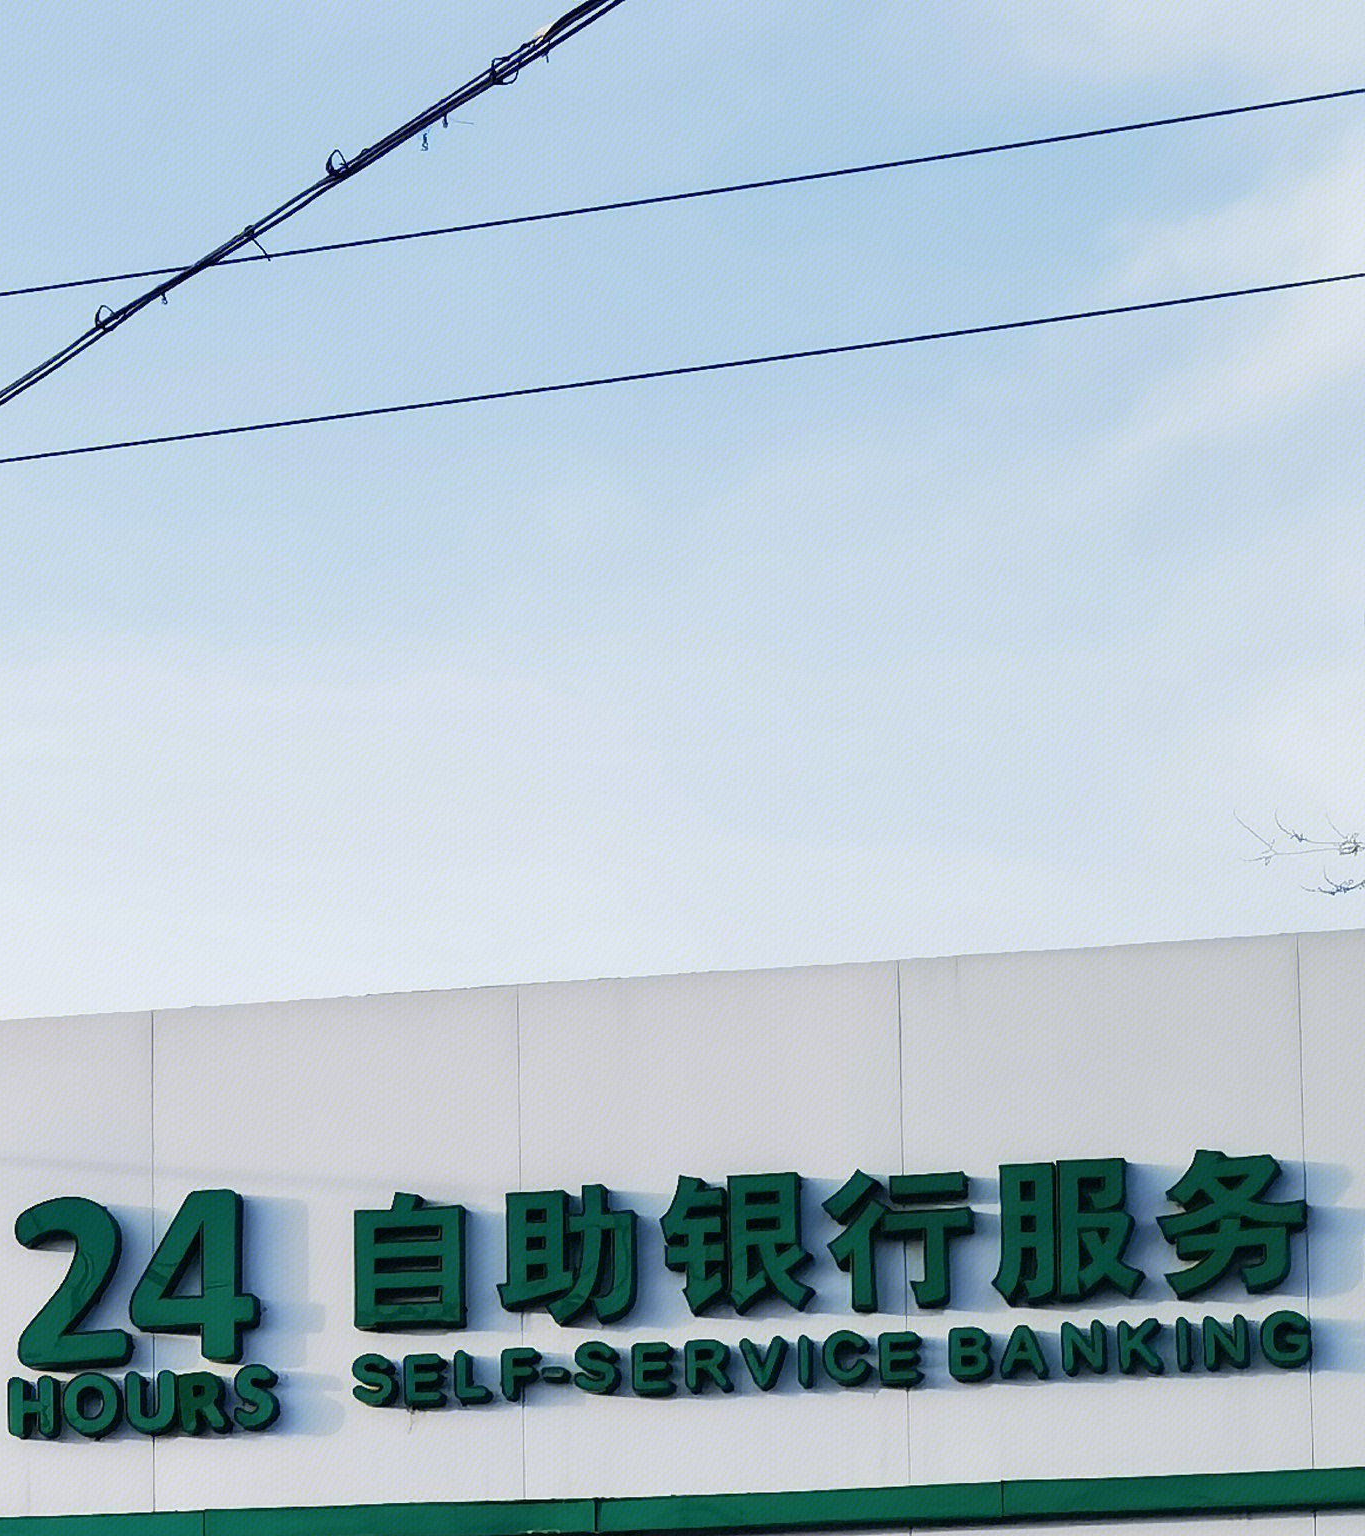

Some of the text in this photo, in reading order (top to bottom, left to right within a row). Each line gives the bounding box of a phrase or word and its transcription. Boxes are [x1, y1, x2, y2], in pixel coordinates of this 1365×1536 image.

[14, 1189, 261, 1371] 24
[354, 1150, 1308, 1331] 自助银行服务
[6, 1363, 281, 1440] HOURS
[352, 1310, 1312, 1410] SELF-SERVICE BANKING
